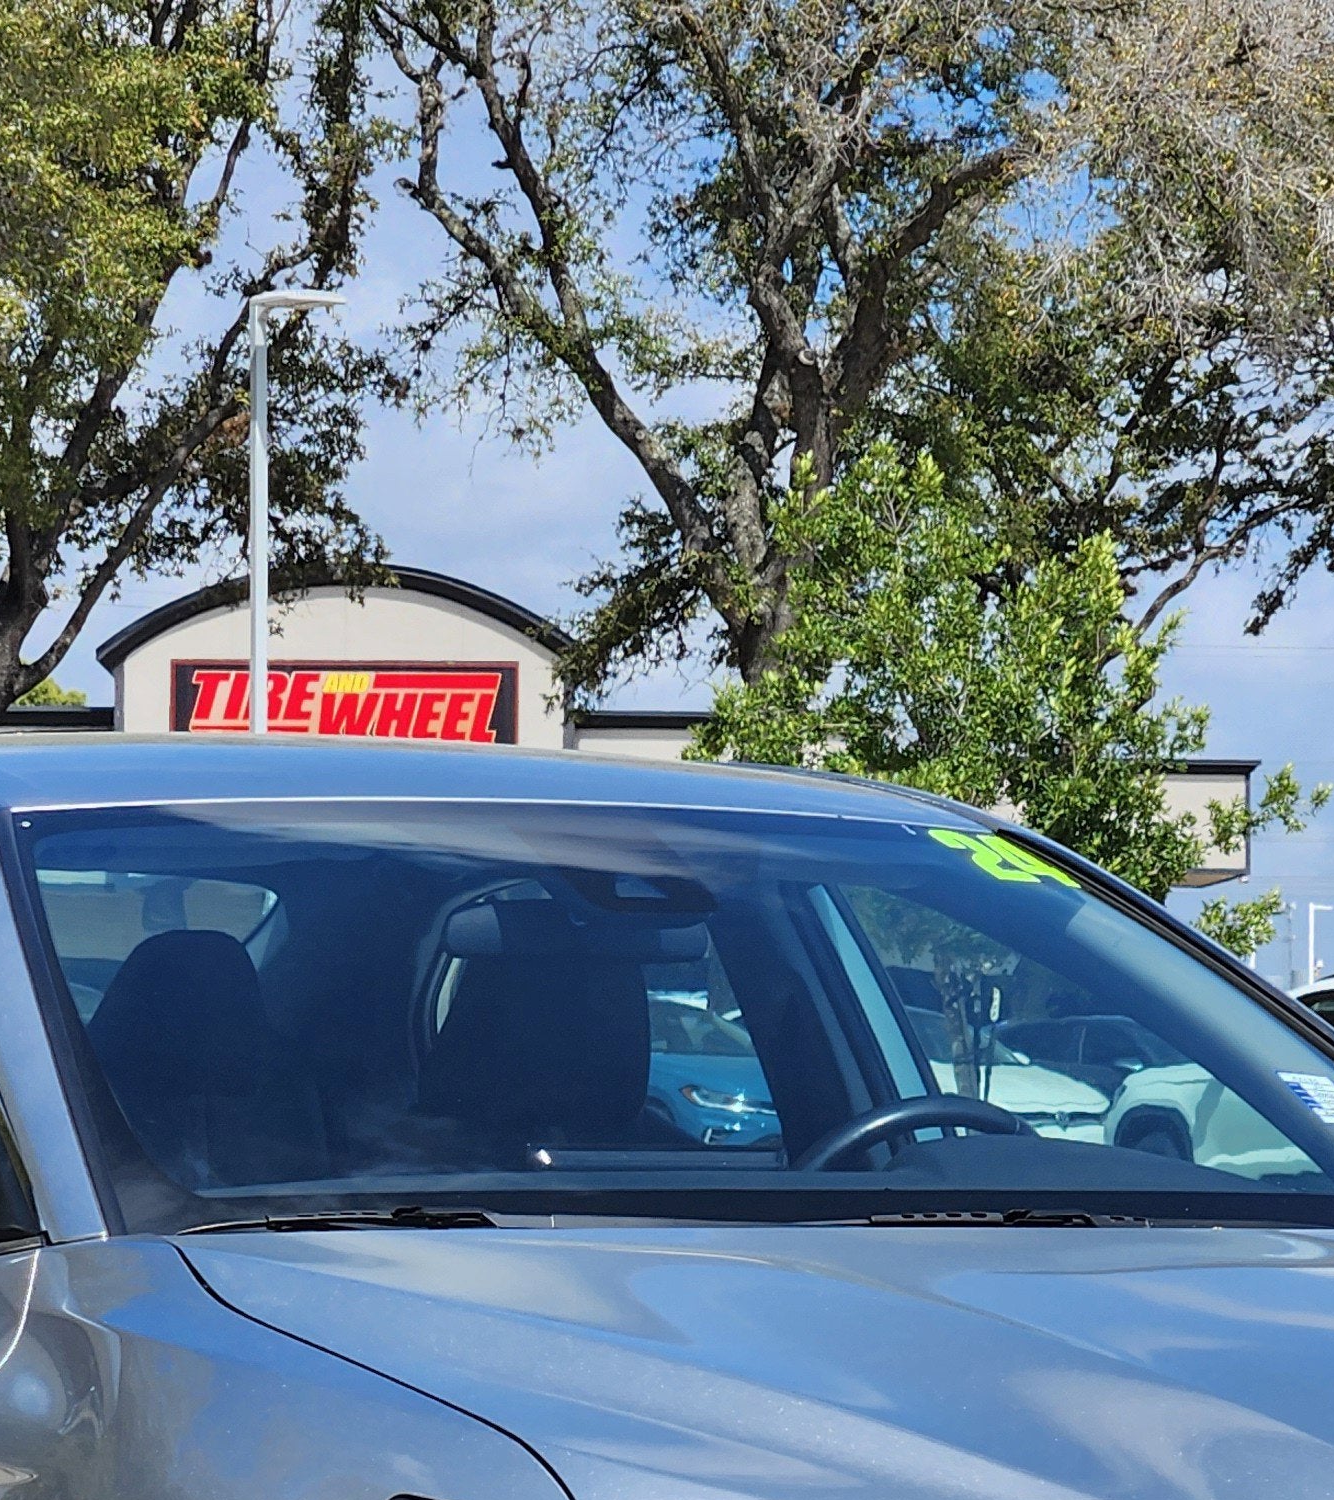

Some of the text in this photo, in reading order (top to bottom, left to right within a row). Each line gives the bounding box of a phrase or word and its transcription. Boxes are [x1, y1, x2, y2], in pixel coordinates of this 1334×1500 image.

[192, 671, 498, 742] TIRE AND WHEEL
[927, 829, 1081, 888] 24
